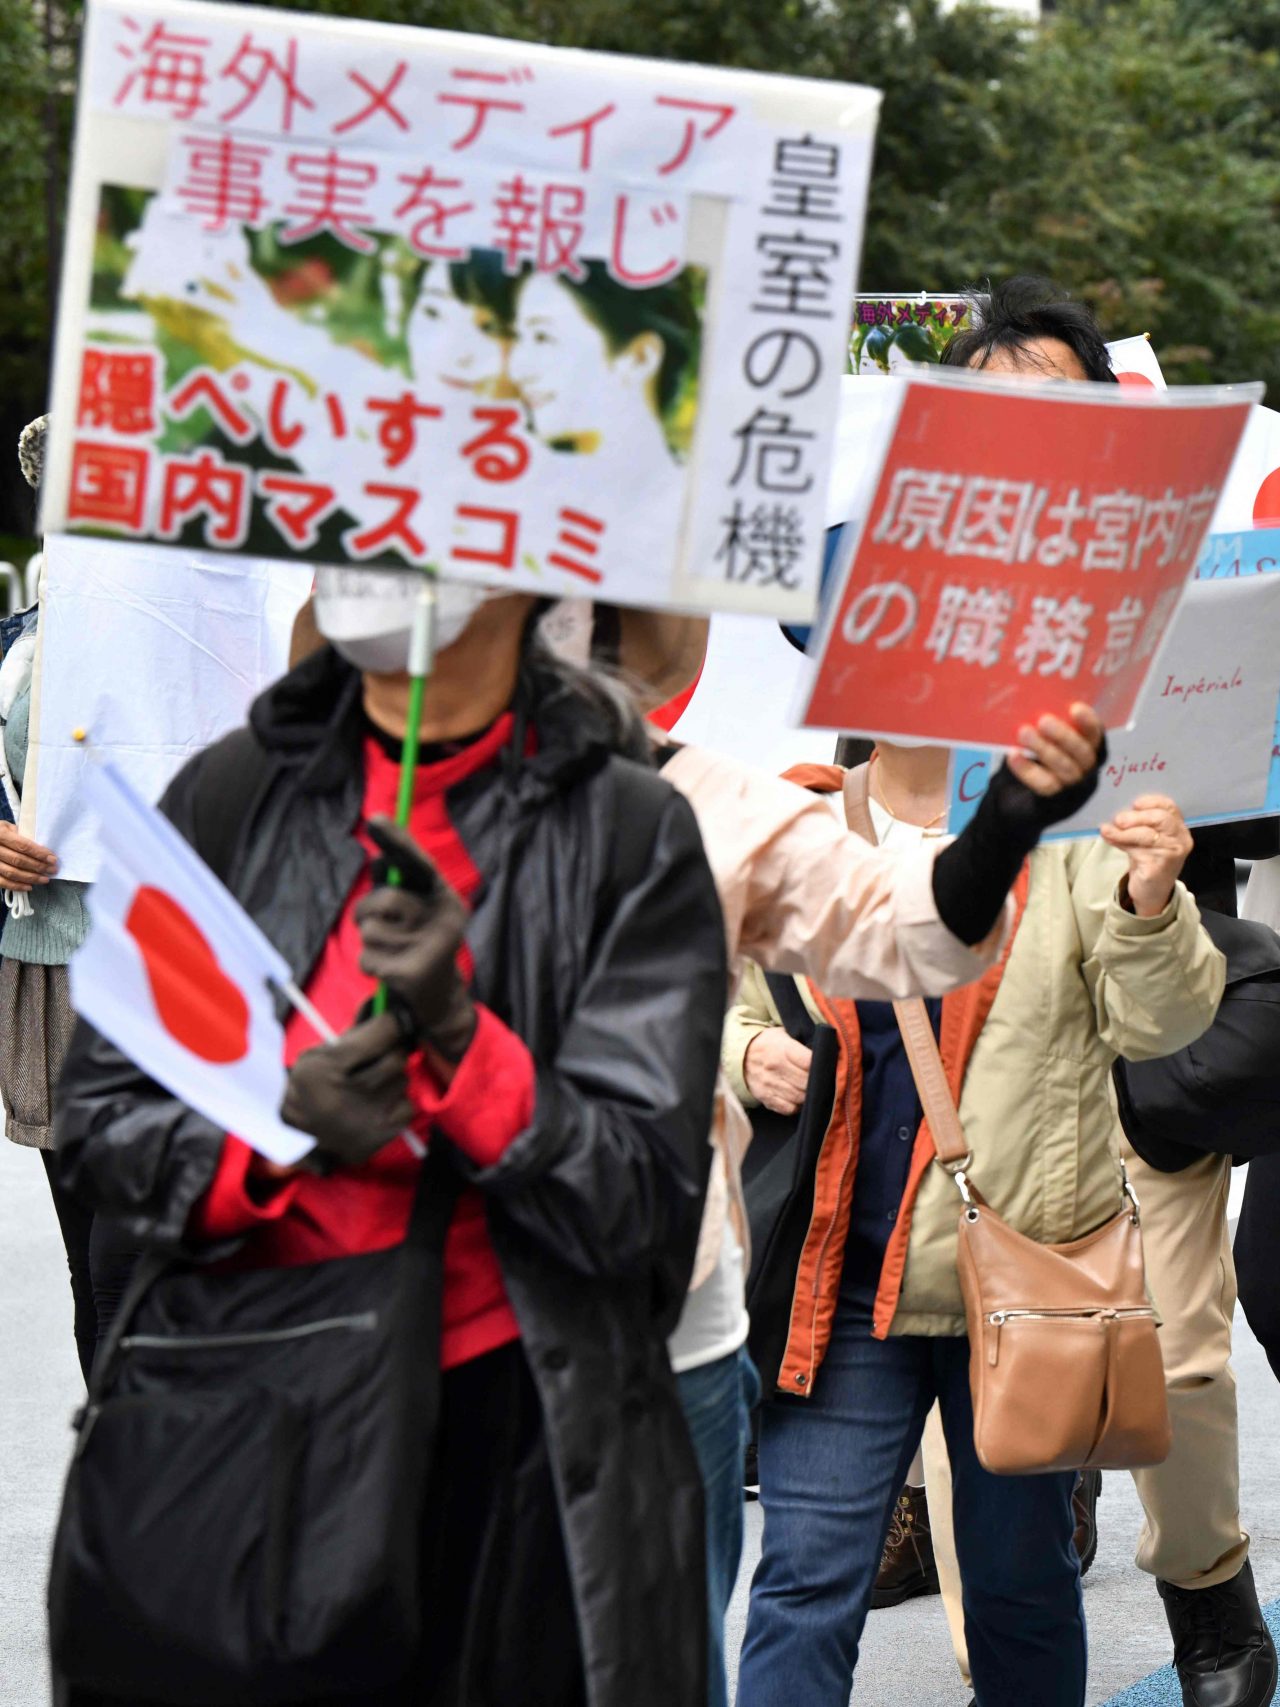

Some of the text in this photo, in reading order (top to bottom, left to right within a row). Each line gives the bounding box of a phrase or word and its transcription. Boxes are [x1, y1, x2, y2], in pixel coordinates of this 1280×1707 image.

[112, 14, 737, 176] 海外メディア
[174, 132, 683, 286] 事実を報じ
[716, 134, 844, 591] 皇室の危機
[858, 301, 967, 326] 海外メディア
[76, 348, 531, 483] 隠ぺいする
[66, 440, 605, 584] 国内マスコミ
[842, 581, 1180, 678] の職務怠
[1102, 751, 1168, 787] njuste
